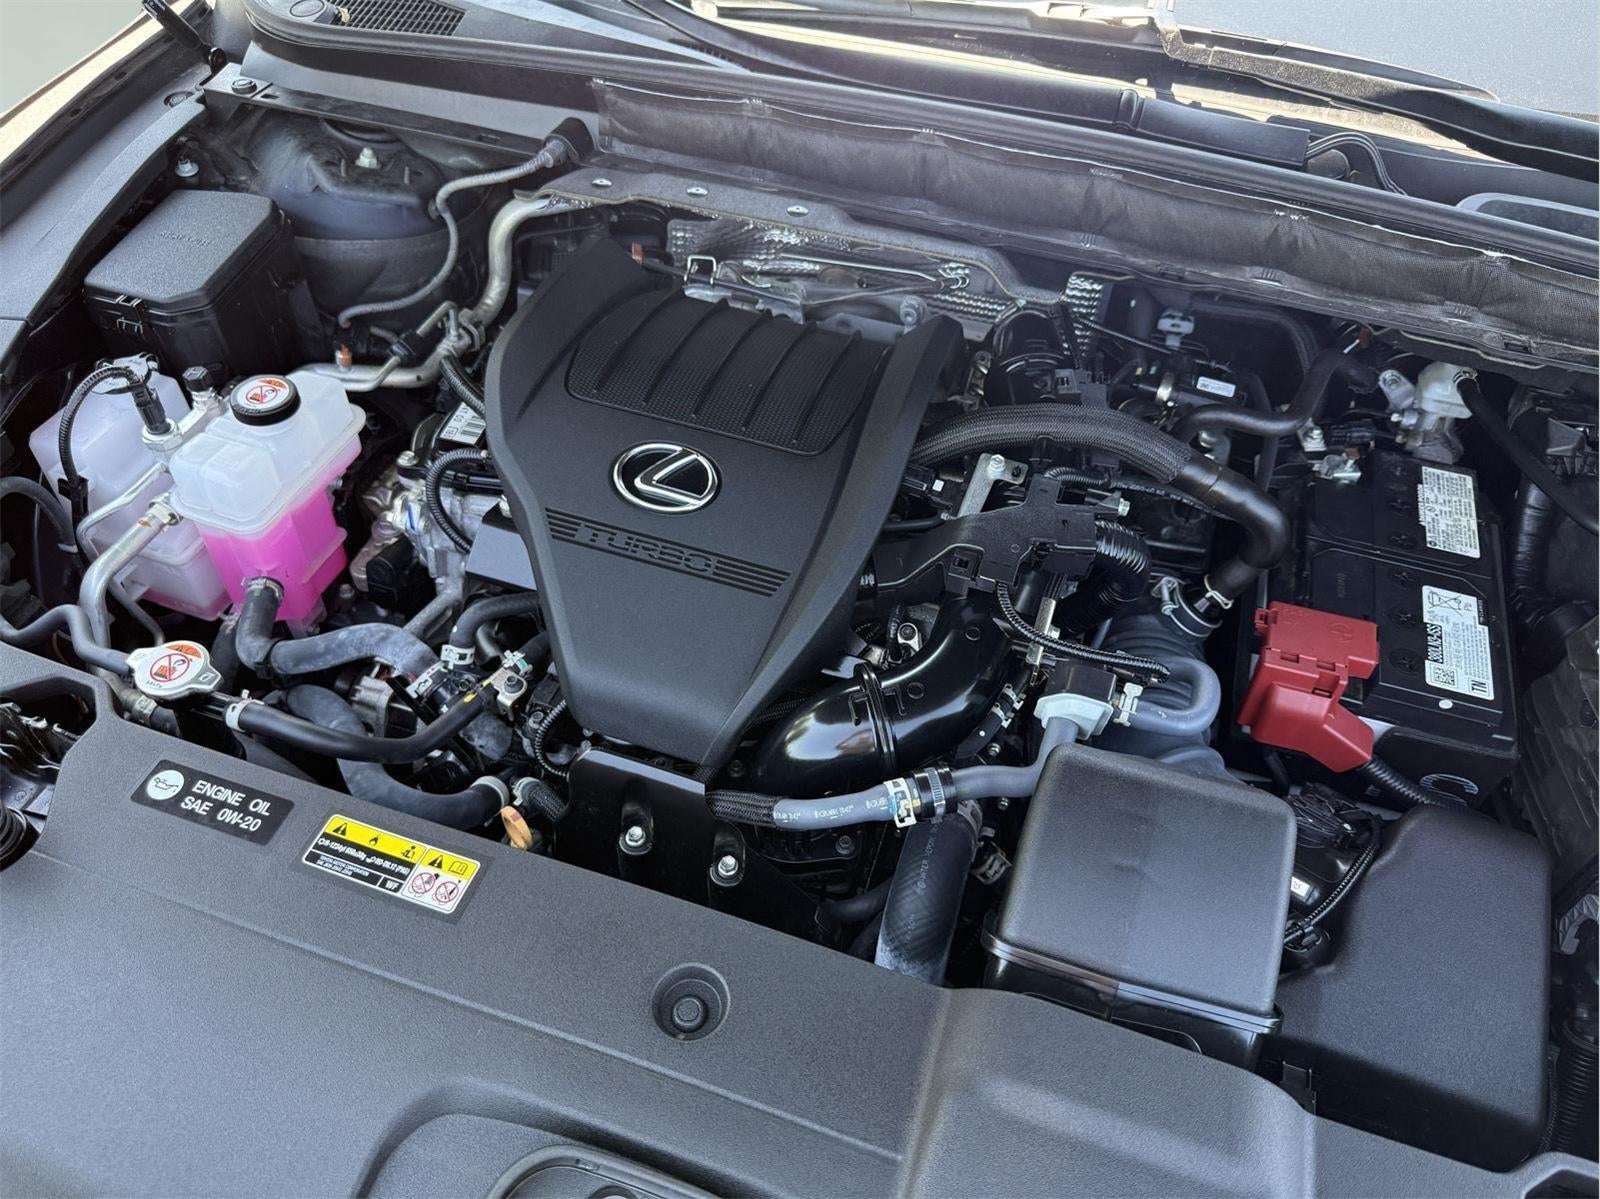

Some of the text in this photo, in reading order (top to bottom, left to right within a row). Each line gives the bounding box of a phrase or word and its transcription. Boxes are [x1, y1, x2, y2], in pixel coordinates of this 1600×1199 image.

[580, 524, 712, 572] TURBO
[181, 796, 261, 832] SAE 0W-20
[192, 780, 272, 816] ENGINE OIL
[385, 880, 399, 890] WF
